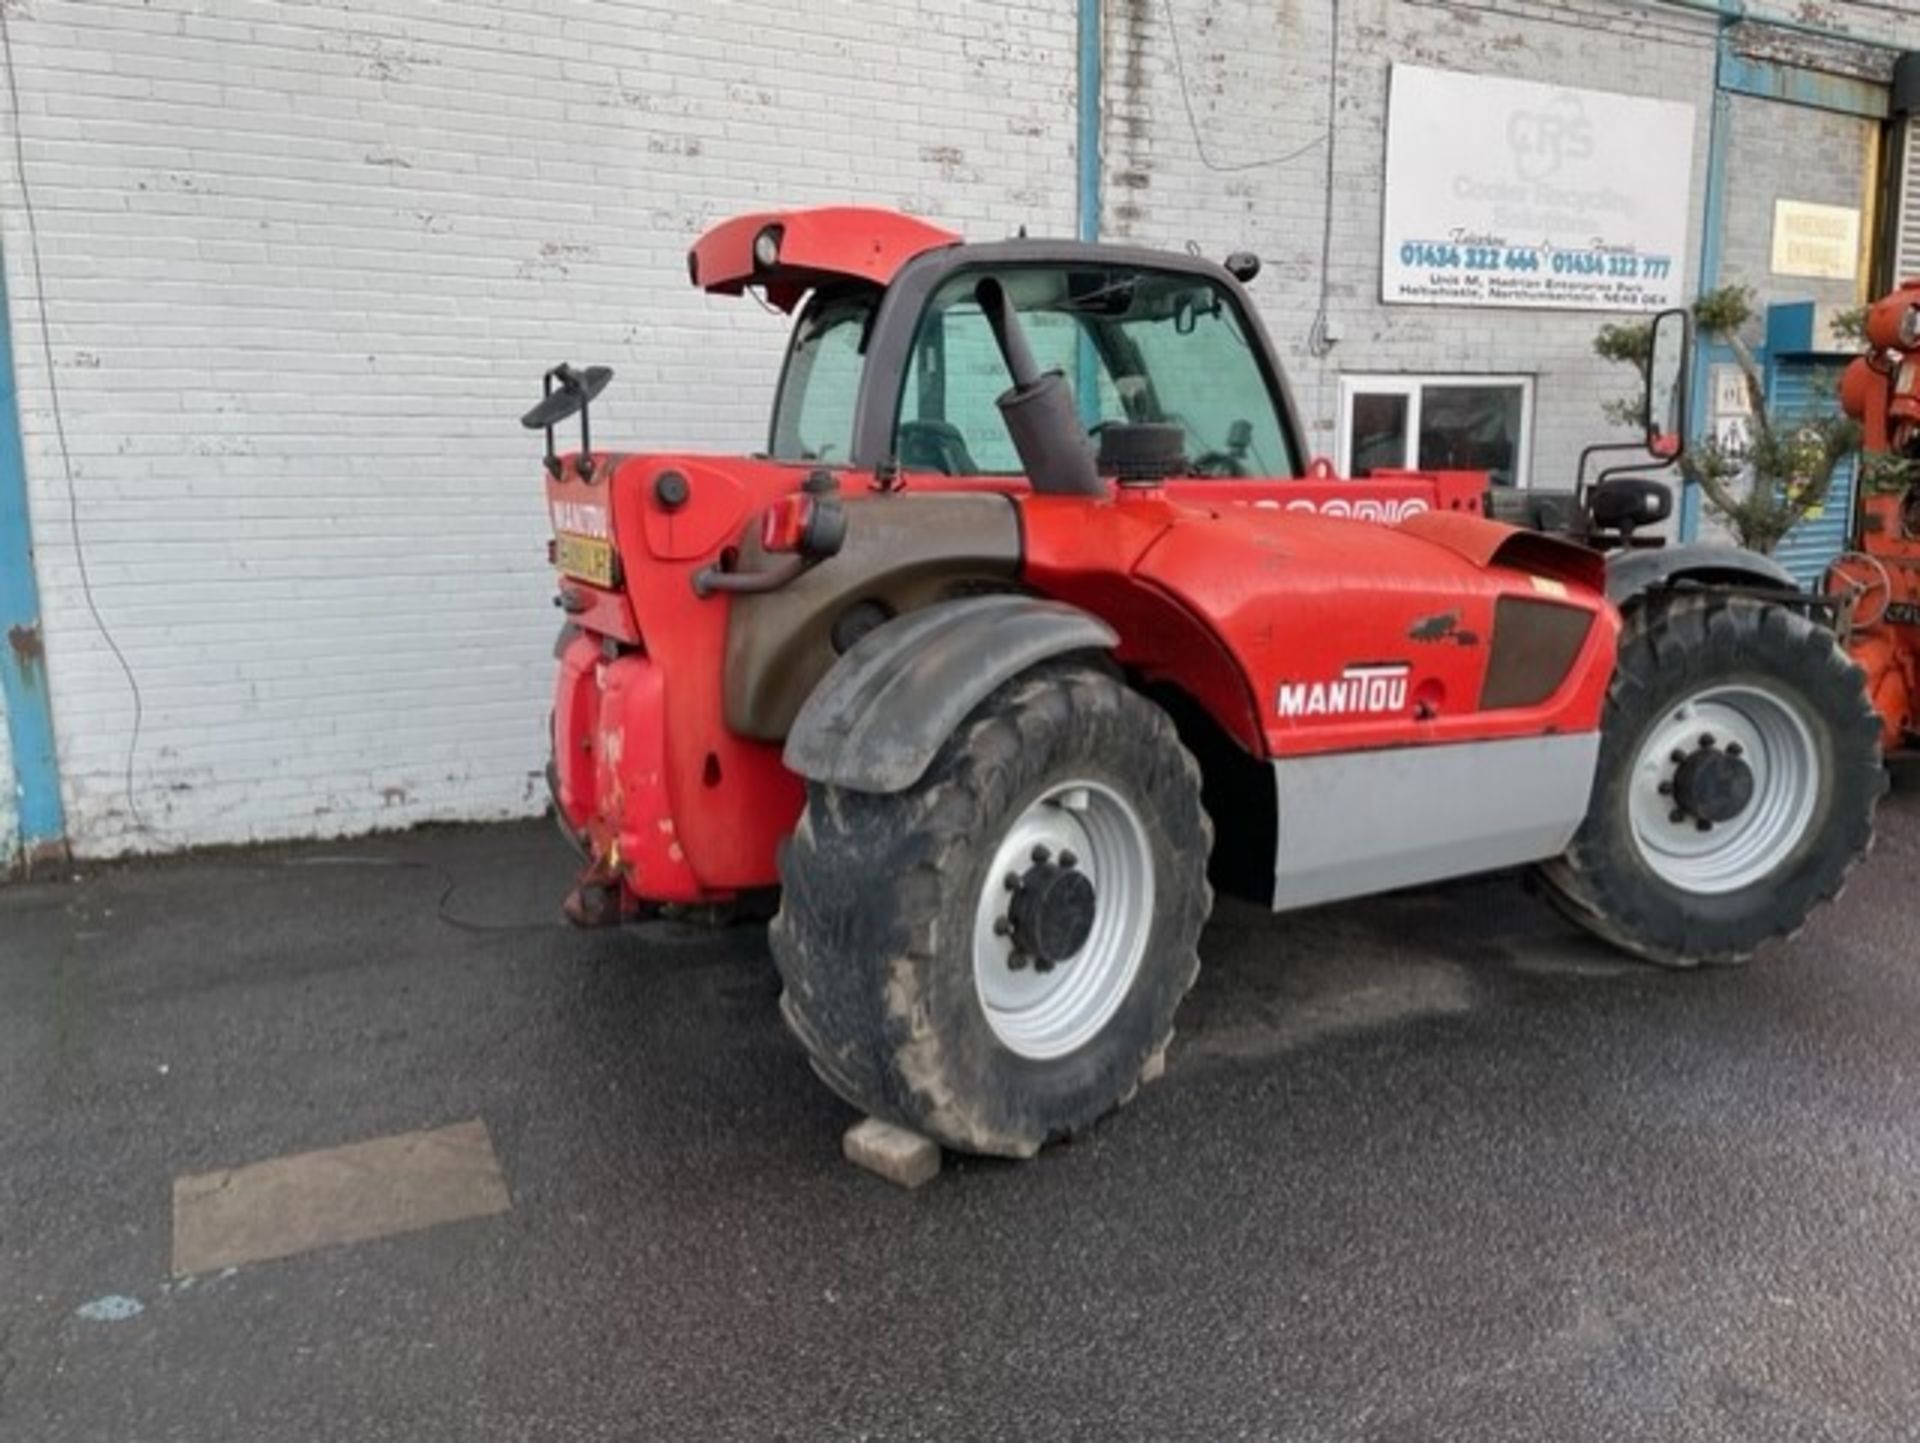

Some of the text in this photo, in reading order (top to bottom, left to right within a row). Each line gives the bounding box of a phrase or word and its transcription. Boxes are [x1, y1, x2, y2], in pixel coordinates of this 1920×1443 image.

[1401, 244, 1538, 272] 01434 322 444
[1553, 252, 1670, 280] 01434 322 777
[1430, 274, 1458, 285] Unit
[1489, 277, 1540, 288] Hadrian
[1545, 279, 1612, 291] Enterprise
[1616, 282, 1643, 292] Park
[1278, 665, 1409, 718] MANITOU
